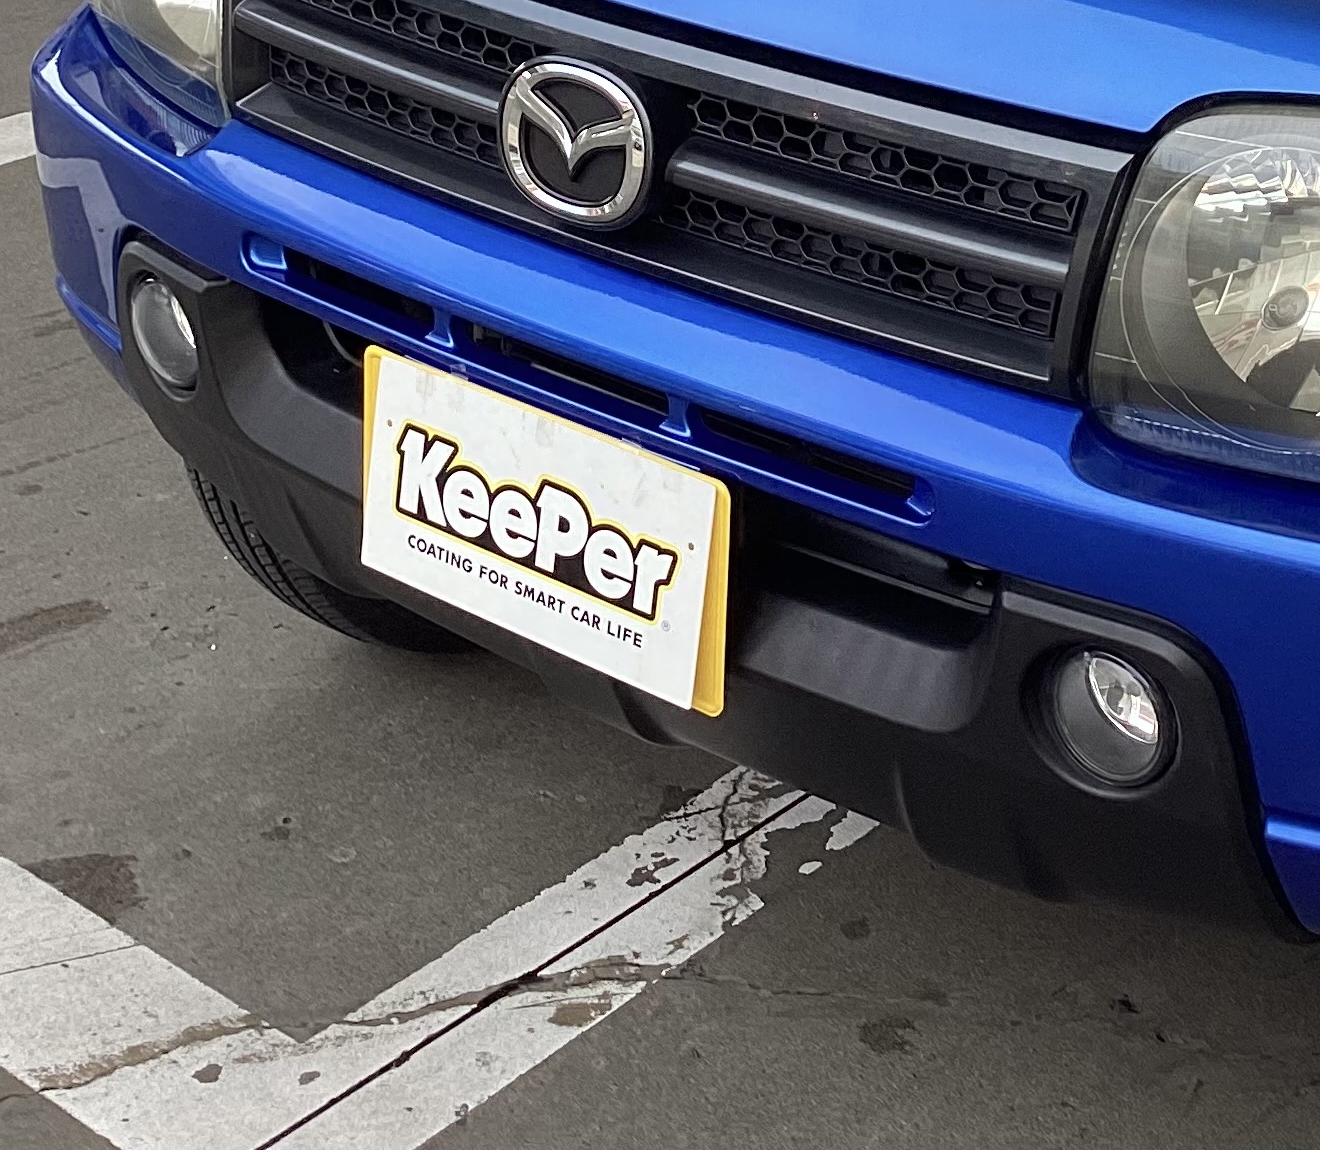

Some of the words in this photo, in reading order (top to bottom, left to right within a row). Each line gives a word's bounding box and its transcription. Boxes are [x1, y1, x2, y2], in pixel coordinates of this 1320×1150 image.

[397, 425, 676, 618] KeePer
[407, 534, 473, 573] COATING
[479, 565, 508, 590] FOR
[514, 580, 566, 614] SMART
[571, 606, 601, 630] CAR
[606, 619, 644, 649] LIFE
